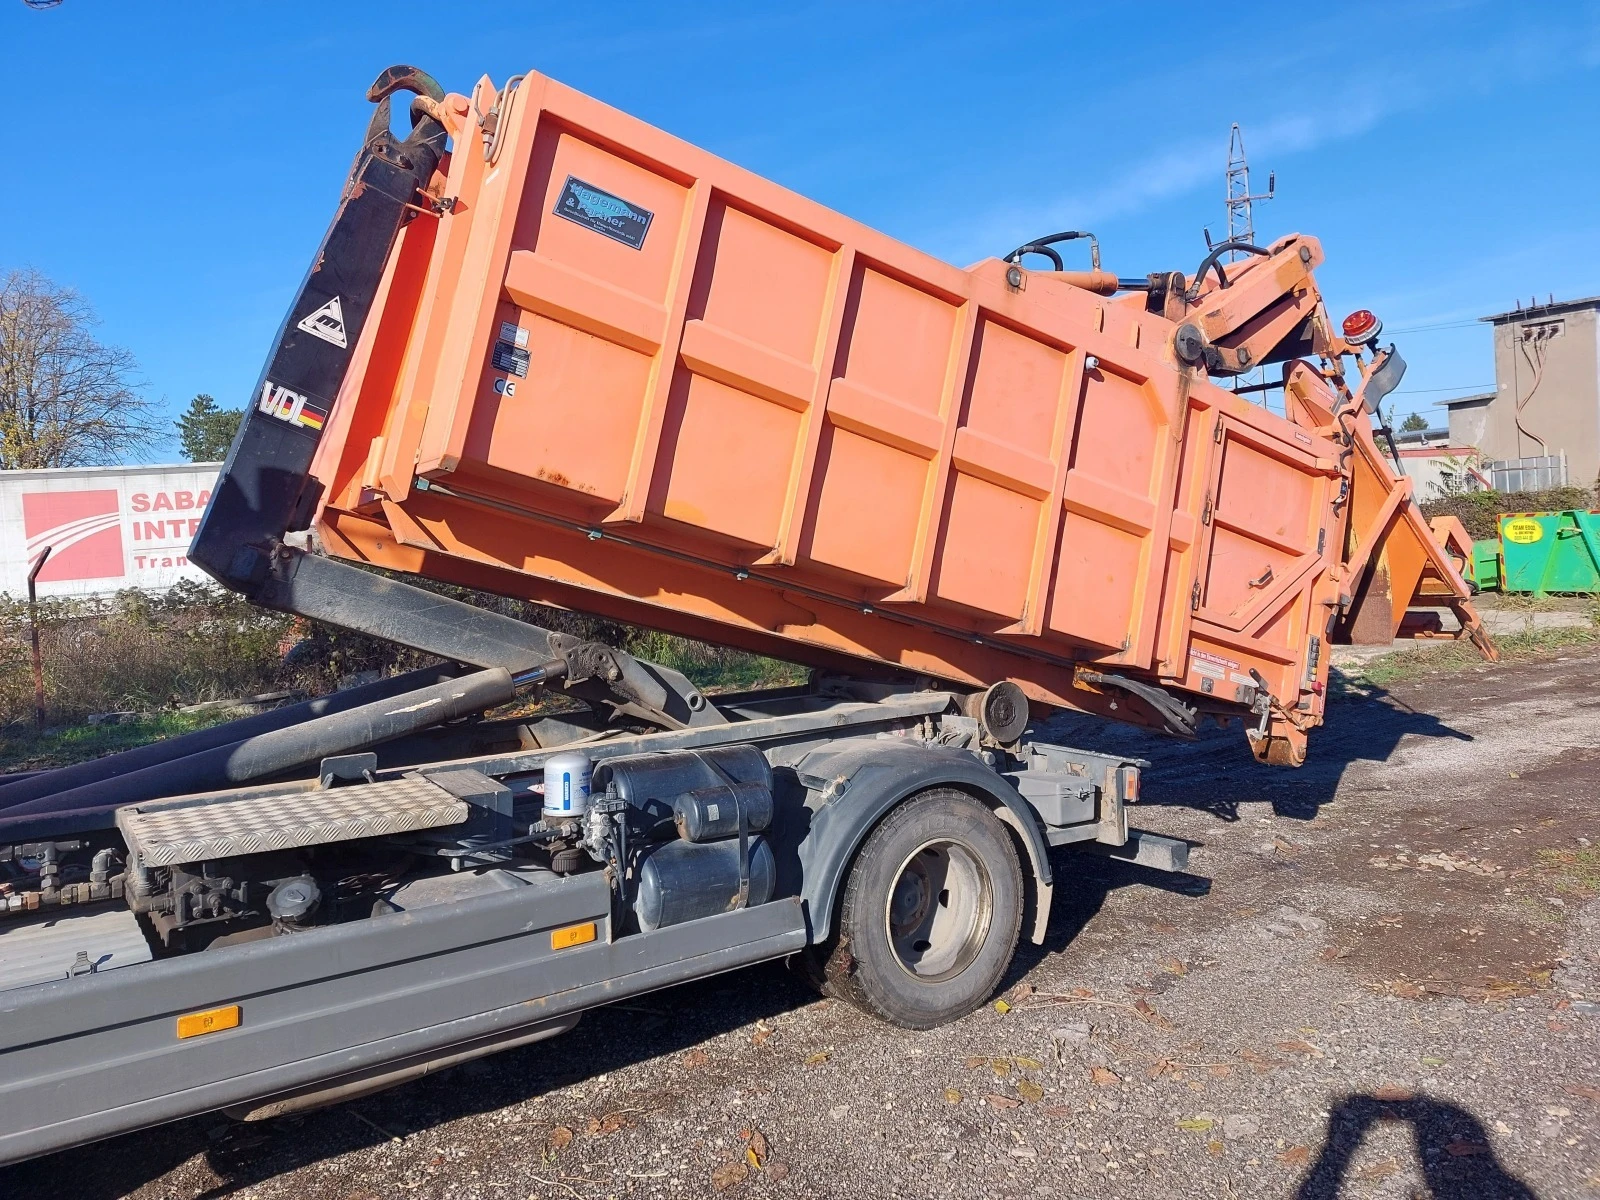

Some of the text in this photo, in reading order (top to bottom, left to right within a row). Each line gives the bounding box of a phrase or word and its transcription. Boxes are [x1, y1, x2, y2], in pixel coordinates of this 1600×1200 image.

[565, 197, 625, 228] & Partner
[259, 380, 308, 428] VDL
